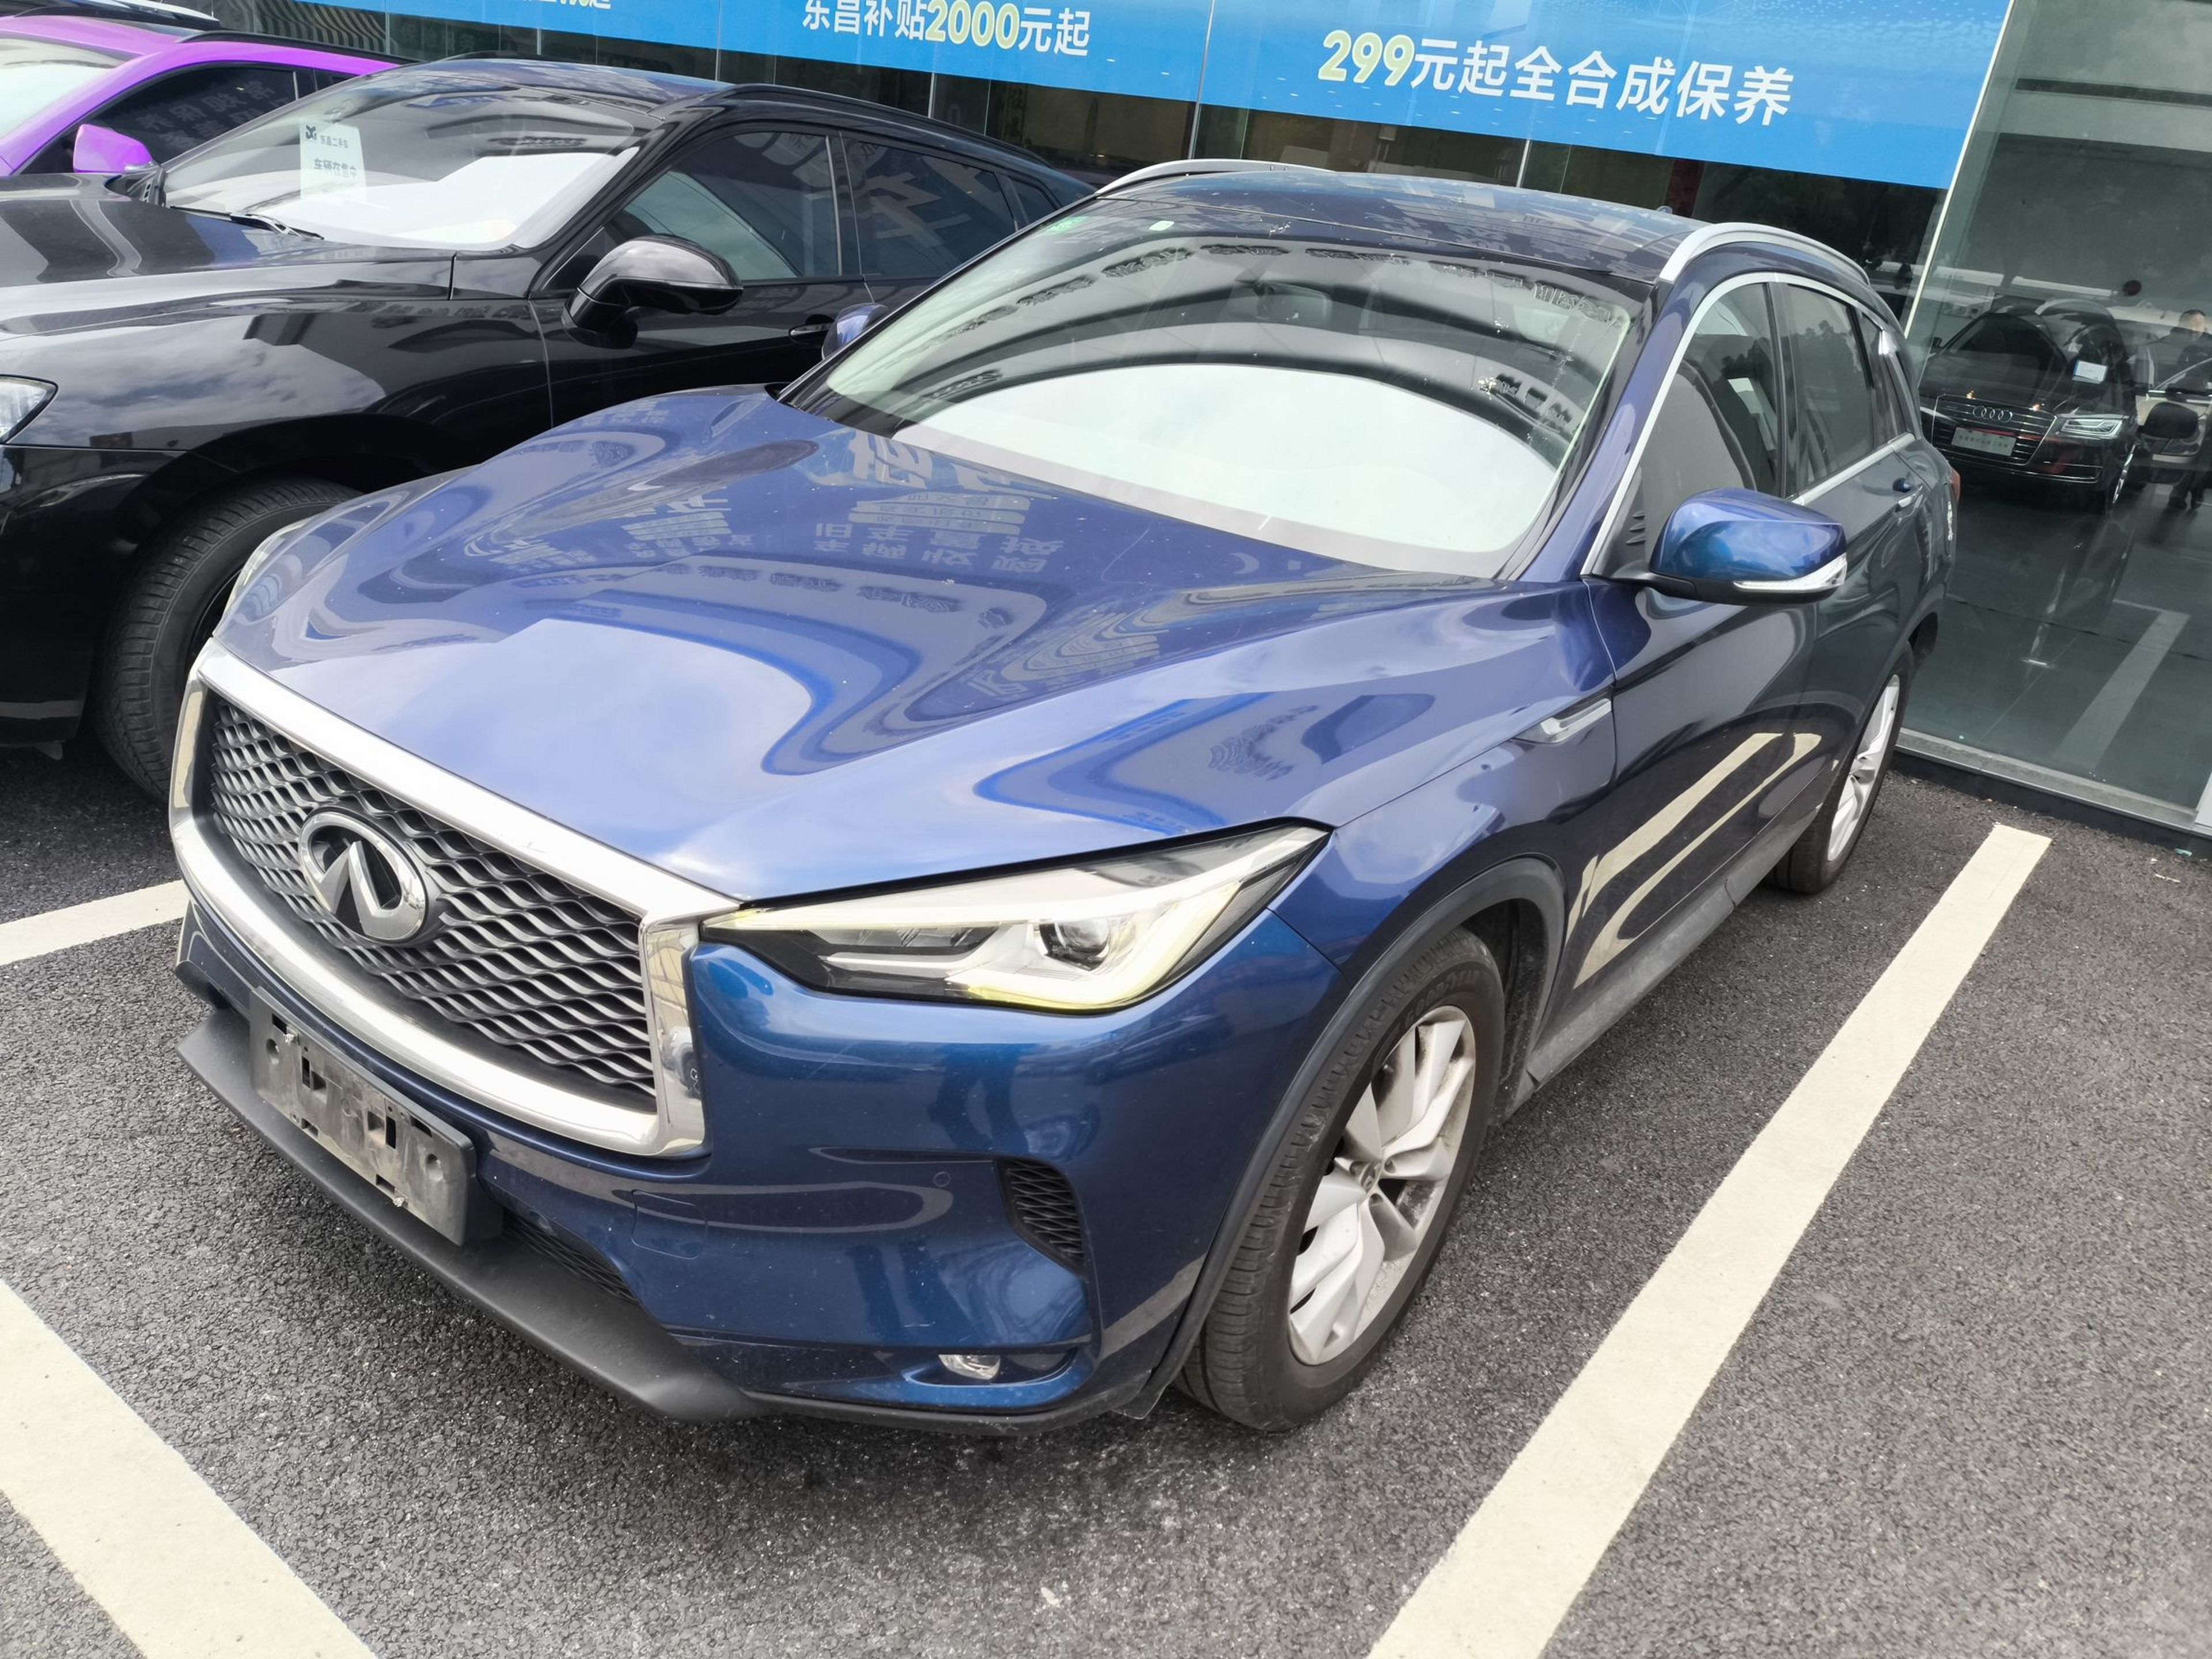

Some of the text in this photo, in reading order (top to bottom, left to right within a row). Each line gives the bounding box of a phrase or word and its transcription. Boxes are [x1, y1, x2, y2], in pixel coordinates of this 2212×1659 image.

[802, 0, 1090, 56] 东昌补贴2000元起
[1317, 29, 1794, 126] 299元起全合成保养
